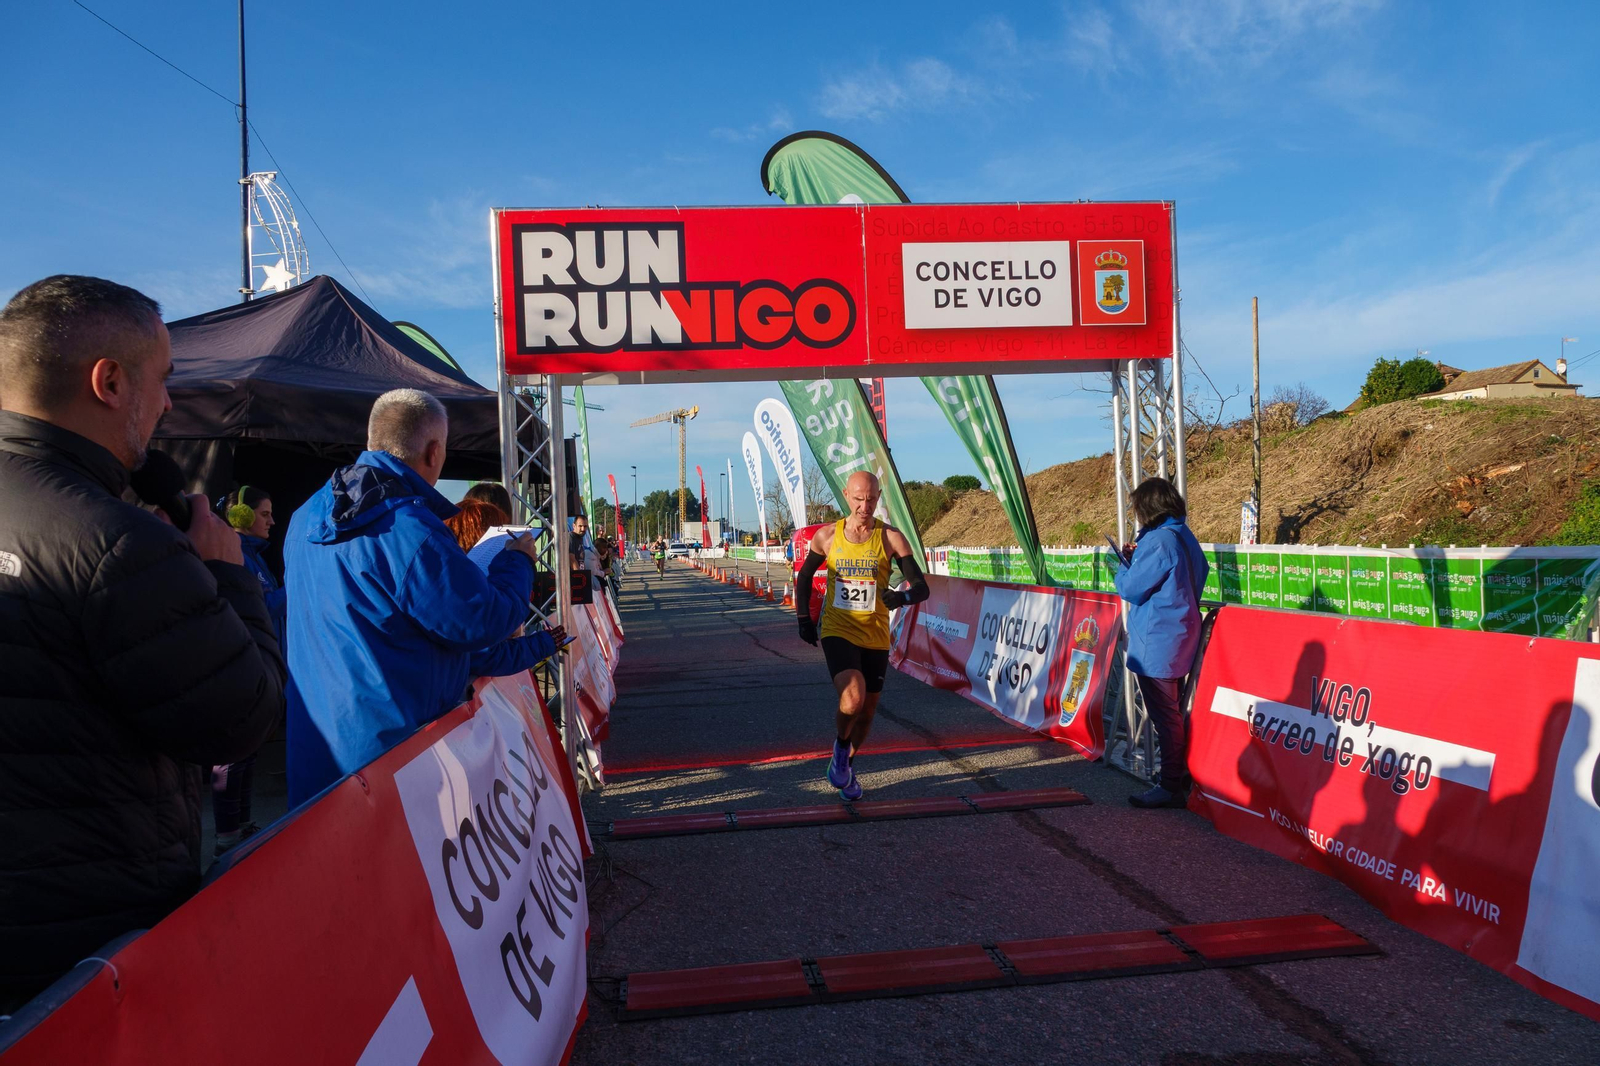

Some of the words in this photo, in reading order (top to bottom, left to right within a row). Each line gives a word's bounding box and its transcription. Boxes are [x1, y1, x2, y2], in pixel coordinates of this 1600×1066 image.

[872, 215, 949, 237] Subida
[958, 216, 985, 235] Ao
[993, 215, 1065, 235] Castro
[521, 230, 680, 287] RUN
[915, 260, 1057, 282] CONCELLO
[934, 288, 968, 309] DE
[978, 286, 1042, 308] VIGO
[836, 559, 879, 568] ATHLETICS
[841, 587, 868, 602] 321
[981, 612, 1049, 655] CONCELLO
[977, 651, 999, 681] DE
[1309, 676, 1377, 738] VIGO,
[1246, 704, 1316, 756] terreo
[1322, 724, 1355, 767] de
[1361, 741, 1433, 795] xogo
[1345, 846, 1398, 881] CIDADE
[1400, 868, 1447, 903] PARA
[1454, 887, 1501, 925] VIVIR
[499, 897, 556, 1022] DE
[529, 823, 583, 941] VIGO
